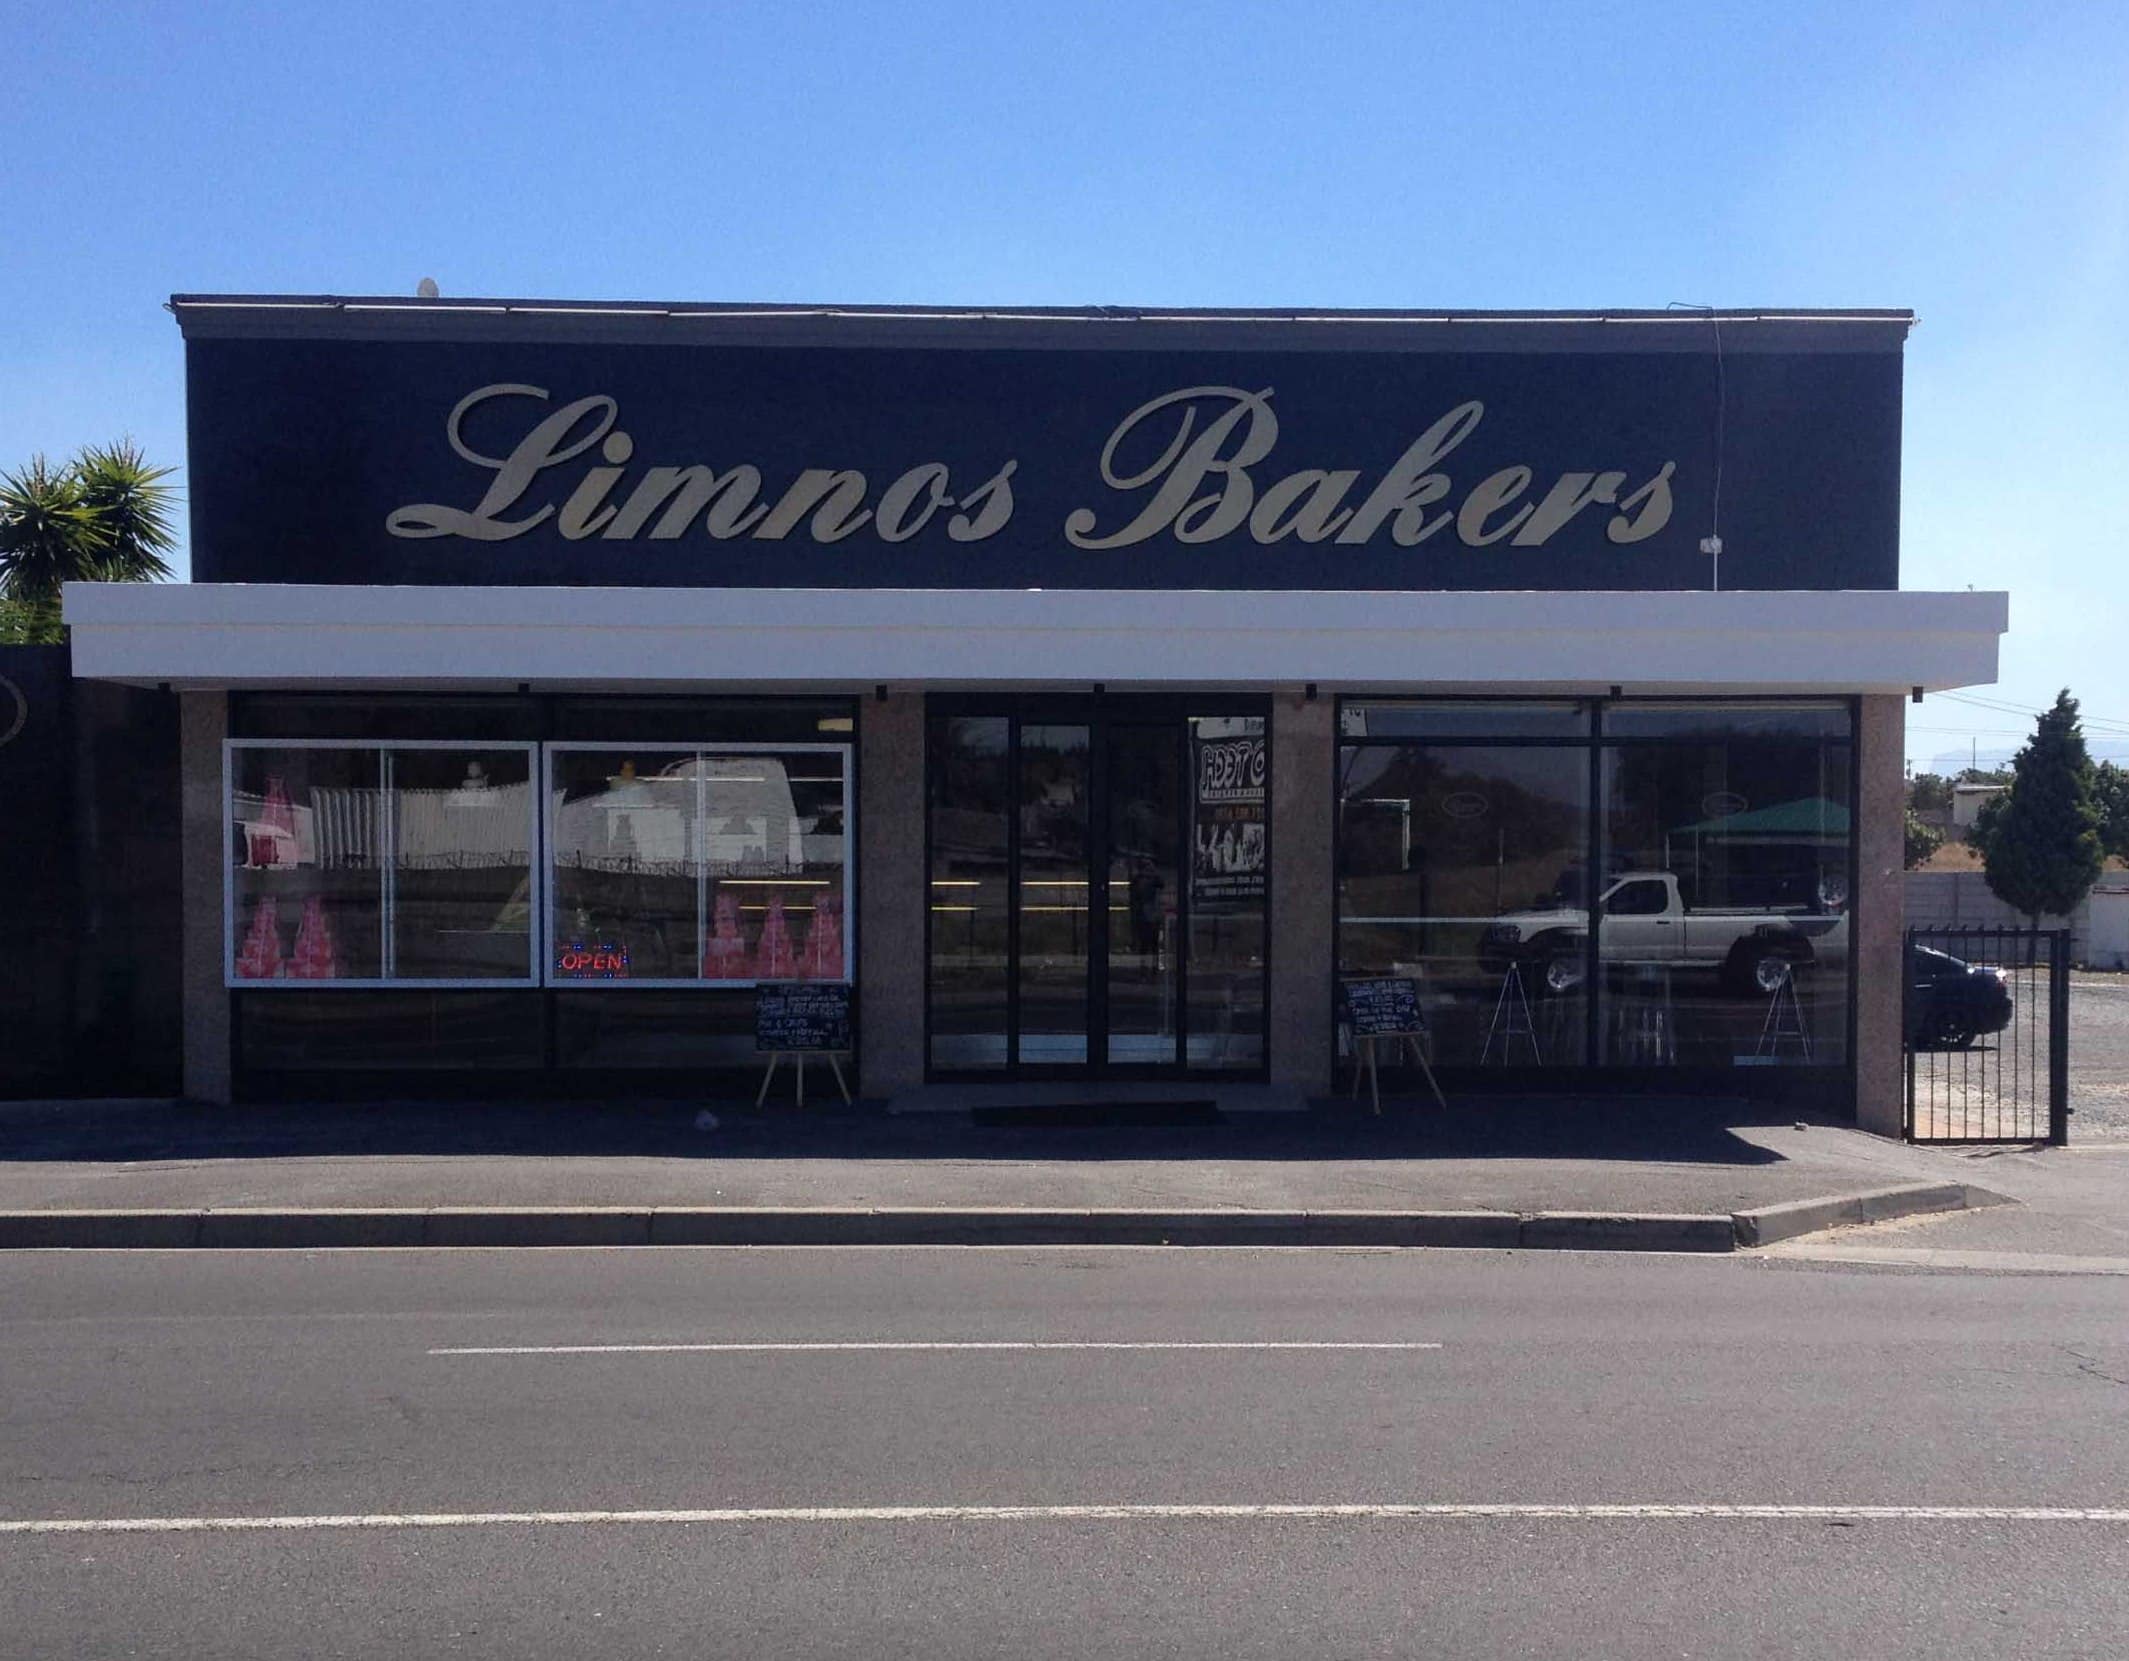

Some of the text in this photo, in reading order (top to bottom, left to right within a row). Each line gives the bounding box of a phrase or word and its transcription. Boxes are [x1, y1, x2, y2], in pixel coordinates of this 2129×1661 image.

[386, 383, 1677, 549] Limnos Bakers
[562, 953, 622, 970] OPEN
